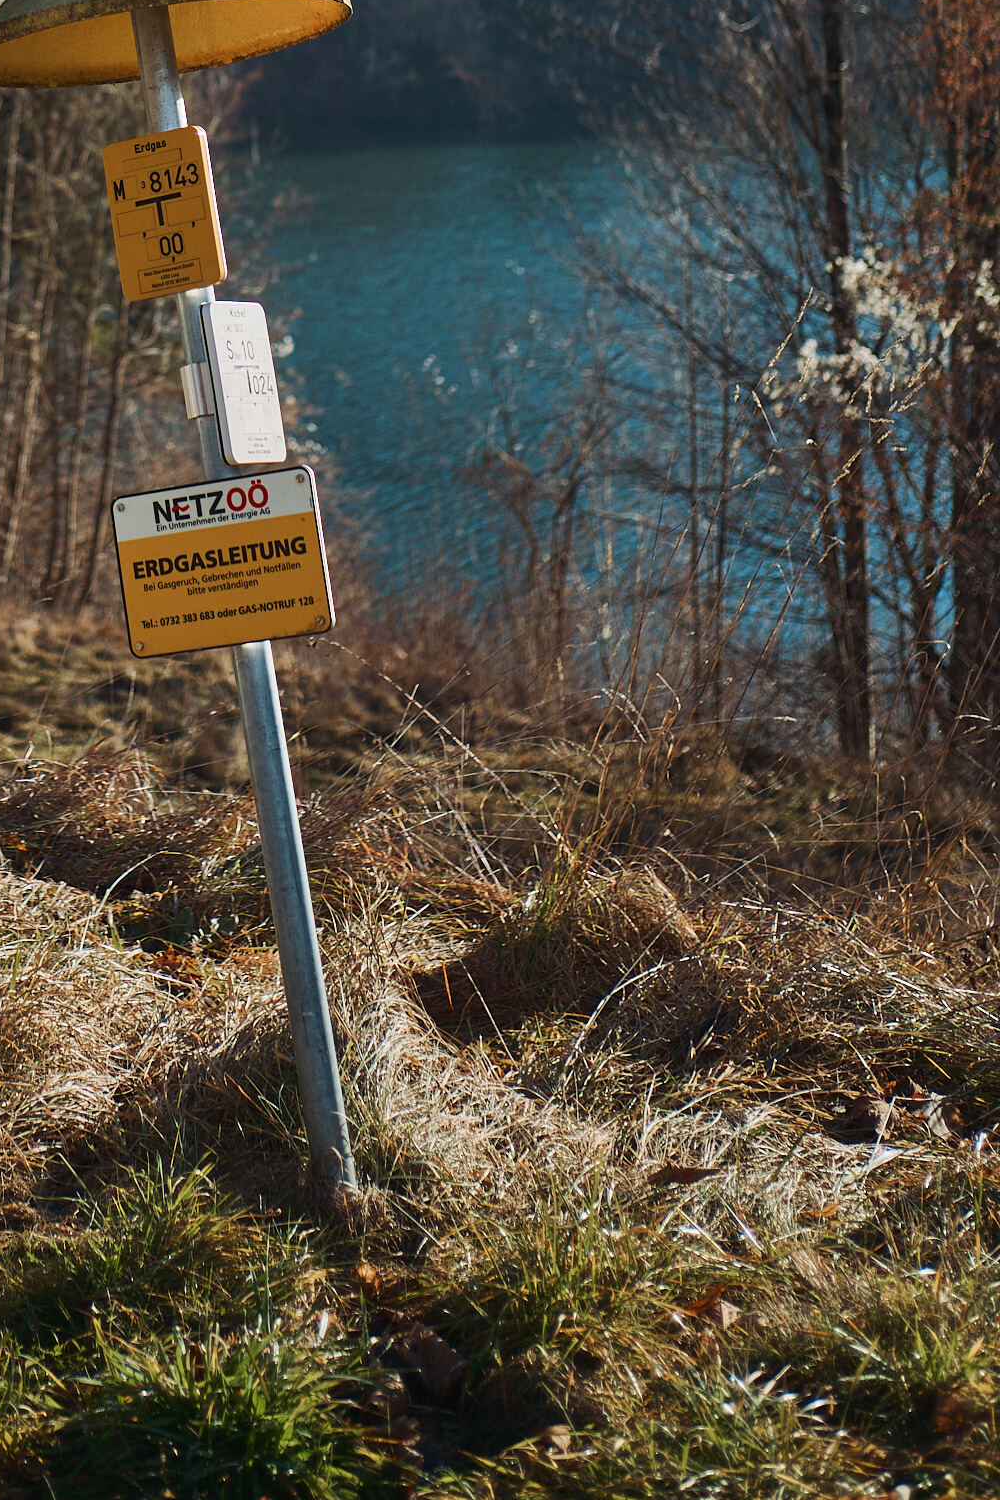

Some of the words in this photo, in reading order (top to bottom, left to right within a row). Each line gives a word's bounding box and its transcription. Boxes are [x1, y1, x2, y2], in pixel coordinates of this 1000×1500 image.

[134, 140, 167, 153] Erdgas
[113, 180, 126, 201] M
[141, 181, 146, 189] 3
[149, 163, 199, 193] 8143
[159, 232, 184, 256] 00
[229, 309, 247, 318] Kabel
[226, 340, 234, 360] S
[241, 340, 255, 360] 10
[156, 524, 167, 532] Ein
[169, 516, 216, 530] Unternehmen
[218, 514, 229, 523] der
[231, 510, 258, 521] Energie
[259, 506, 271, 515] AG
[132, 536, 307, 579] ERDGASLEITUNG
[143, 583, 156, 592] Bei
[157, 576, 200, 591] Gasgeruch,
[202, 569, 244, 583] Gebrechen
[246, 566, 262, 576] und
[263, 561, 301, 574] Notfällen
[187, 585, 206, 596] bitte
[208, 579, 258, 593] verständigen
[141, 619, 158, 629] Tel.:
[160, 615, 181, 627] 0732
[183, 613, 198, 623] 383
[199, 611, 215, 621] 683
[217, 607, 238, 618] oder
[238, 599, 296, 615] GAS-NOTRUF
[298, 596, 315, 607] 128
